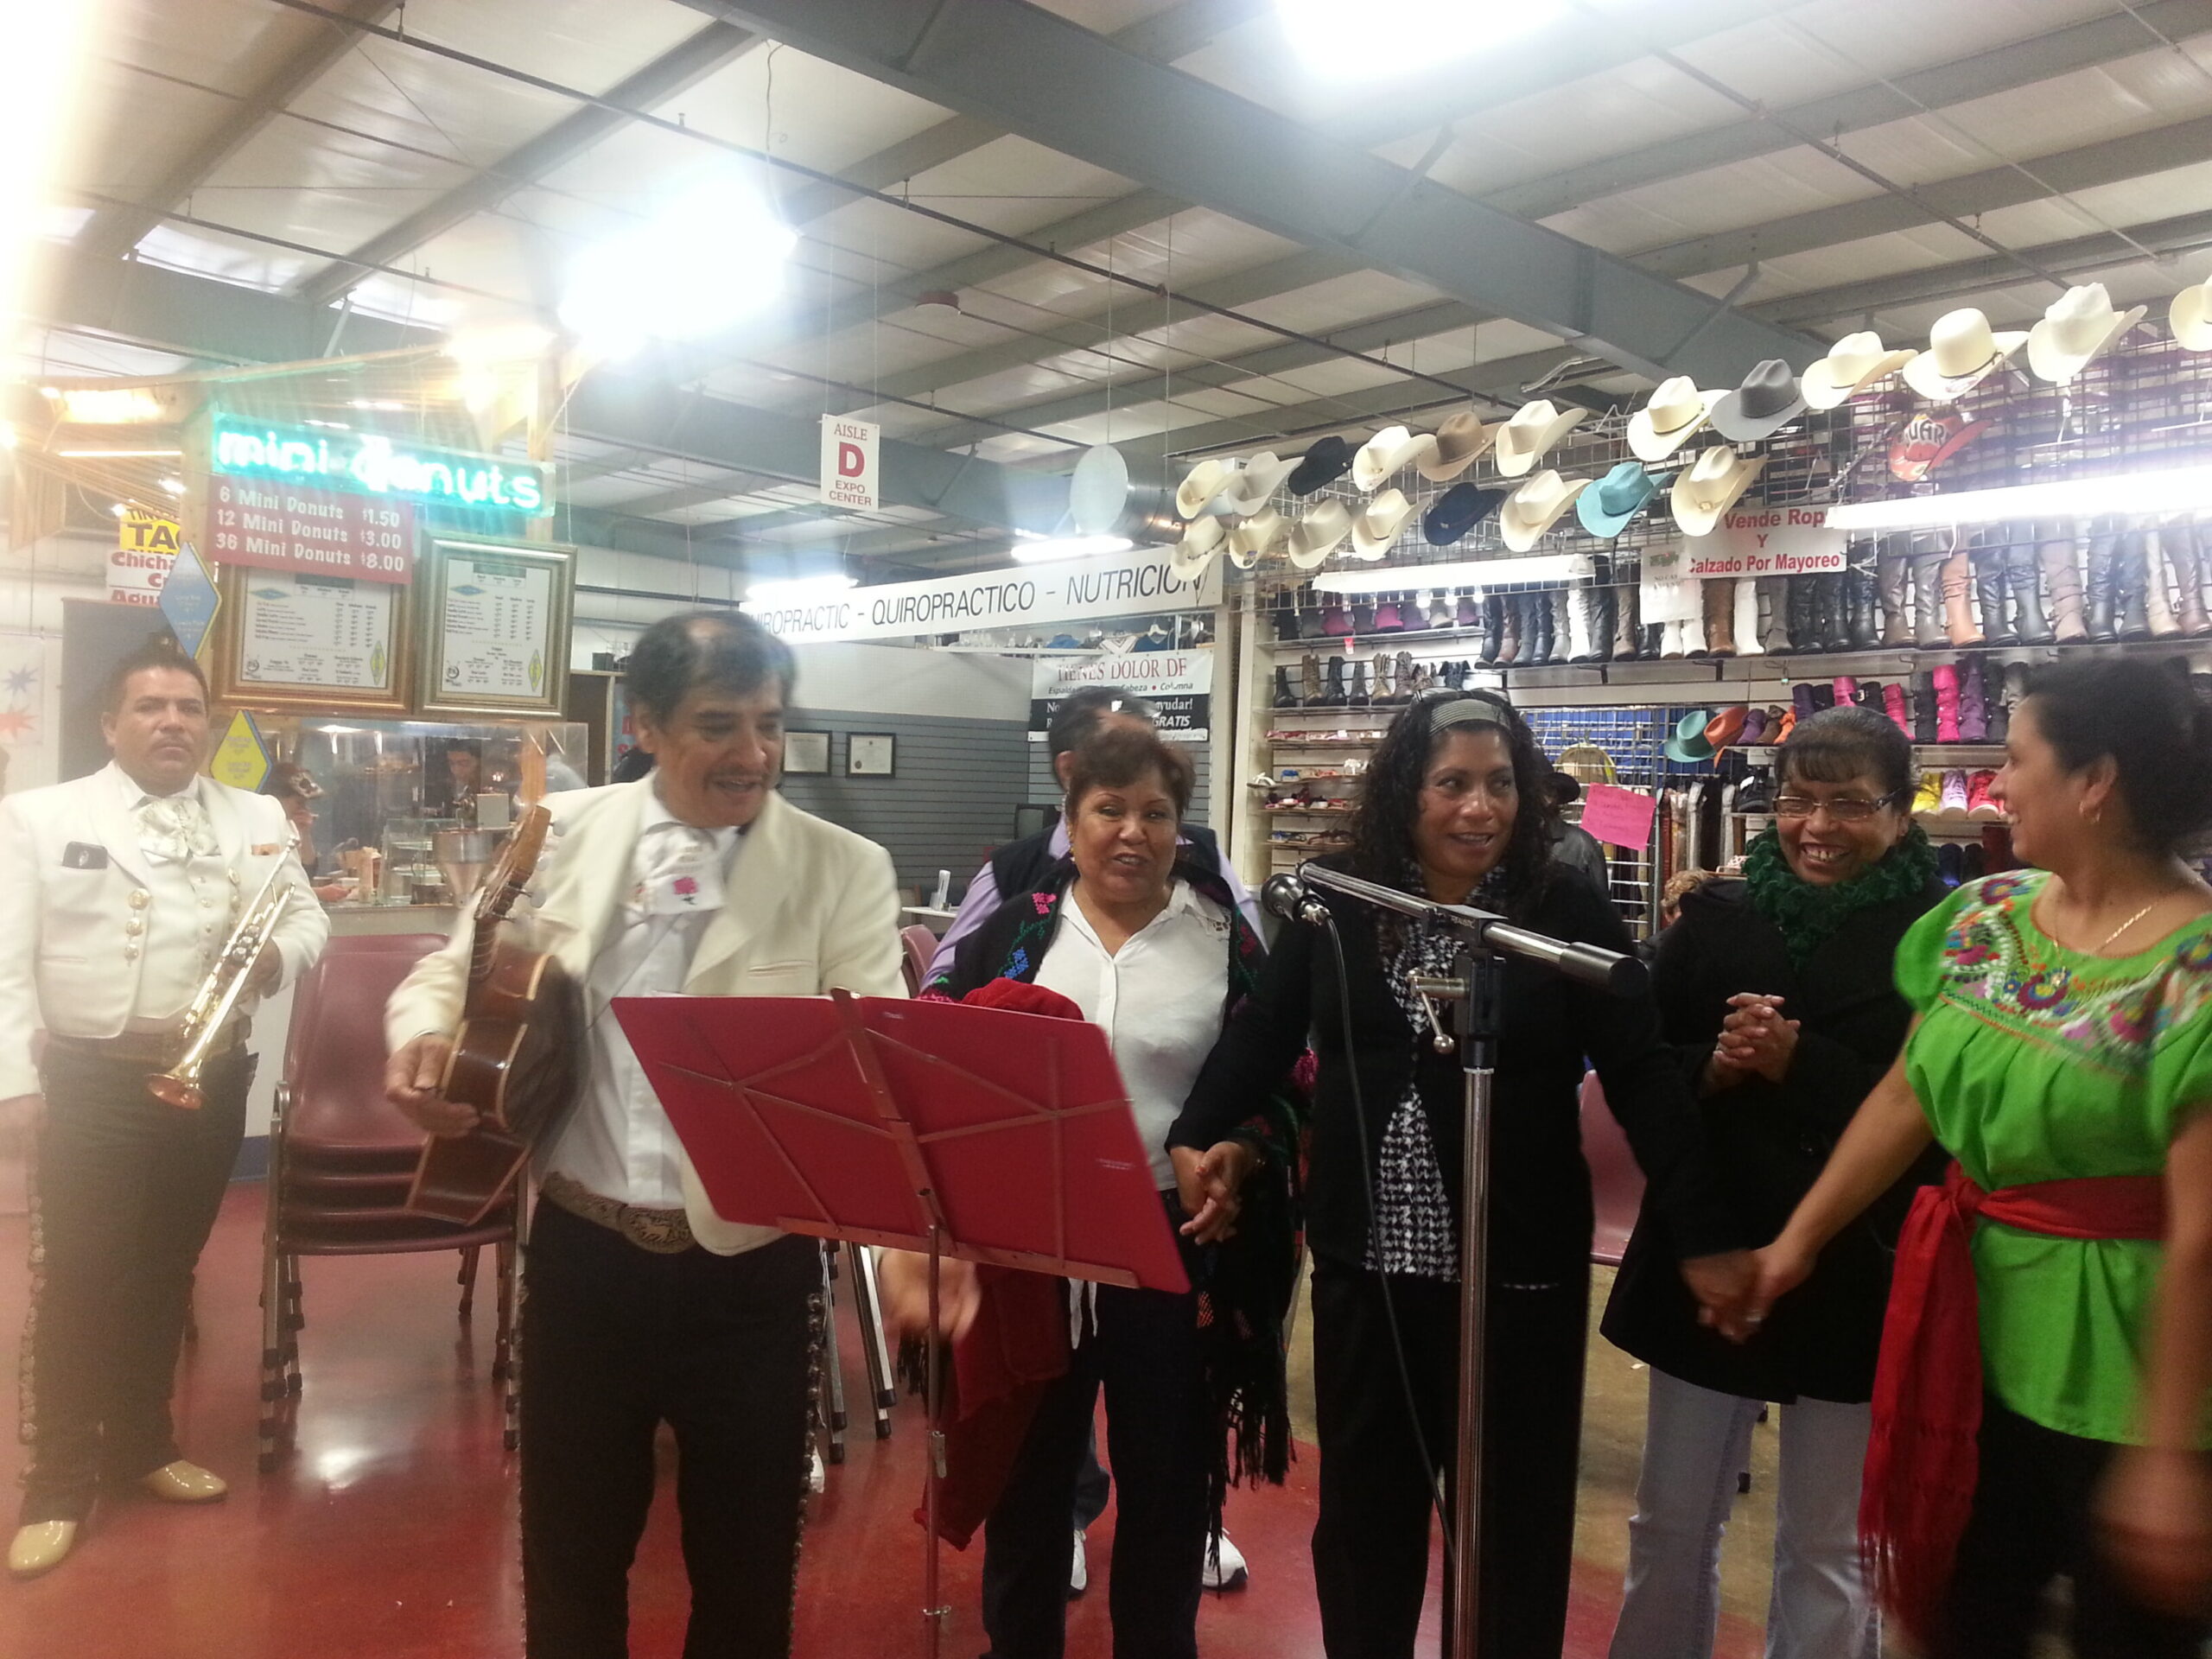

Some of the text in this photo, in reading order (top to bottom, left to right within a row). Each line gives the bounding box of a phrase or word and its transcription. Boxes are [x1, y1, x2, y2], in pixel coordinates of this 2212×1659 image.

[834, 423, 868, 441] AISLE
[218, 430, 330, 474] mini
[838, 442, 865, 477] D
[836, 480, 865, 493] EXPO
[219, 486, 400, 527] 6 Mini Donuts $1.50
[830, 491, 871, 506] CENTER
[218, 509, 401, 550] 12 Mini Donuts $3.00
[1724, 508, 1827, 530] Vende Rop
[127, 524, 180, 550] TA
[1757, 533, 1769, 548] Y
[216, 532, 404, 572] 36 Mini Donuts $8.00
[1746, 555, 1770, 571] Por
[1776, 553, 1840, 575] Mayoreo
[749, 603, 850, 635] IROPRACTIC
[872, 581, 1035, 625] QUIROPRACTICO
[1058, 662, 1105, 682] TIENES
[1111, 659, 1160, 679] DOLOR
[1152, 715, 1191, 728] GRATIS
